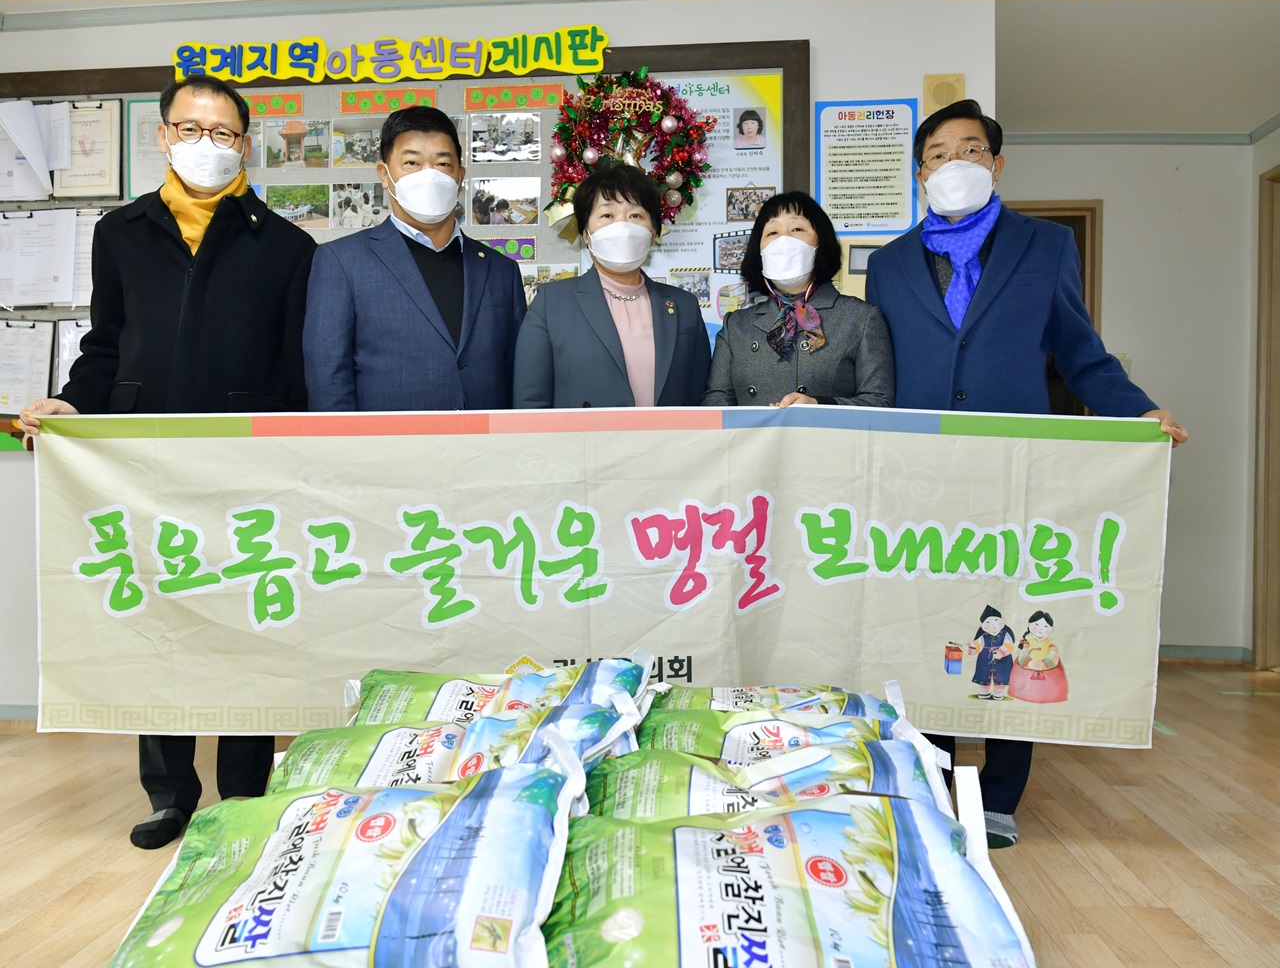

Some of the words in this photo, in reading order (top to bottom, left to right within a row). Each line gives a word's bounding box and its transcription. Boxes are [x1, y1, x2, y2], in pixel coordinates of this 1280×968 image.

[582, 94, 663, 114] Cristmas
[838, 110, 895, 121] 아동권리헌장
[79, 507, 361, 625] 풍요롭고
[389, 506, 608, 624] 즐거운
[631, 496, 781, 610] 명절
[800, 508, 1120, 610] 보내세요!
